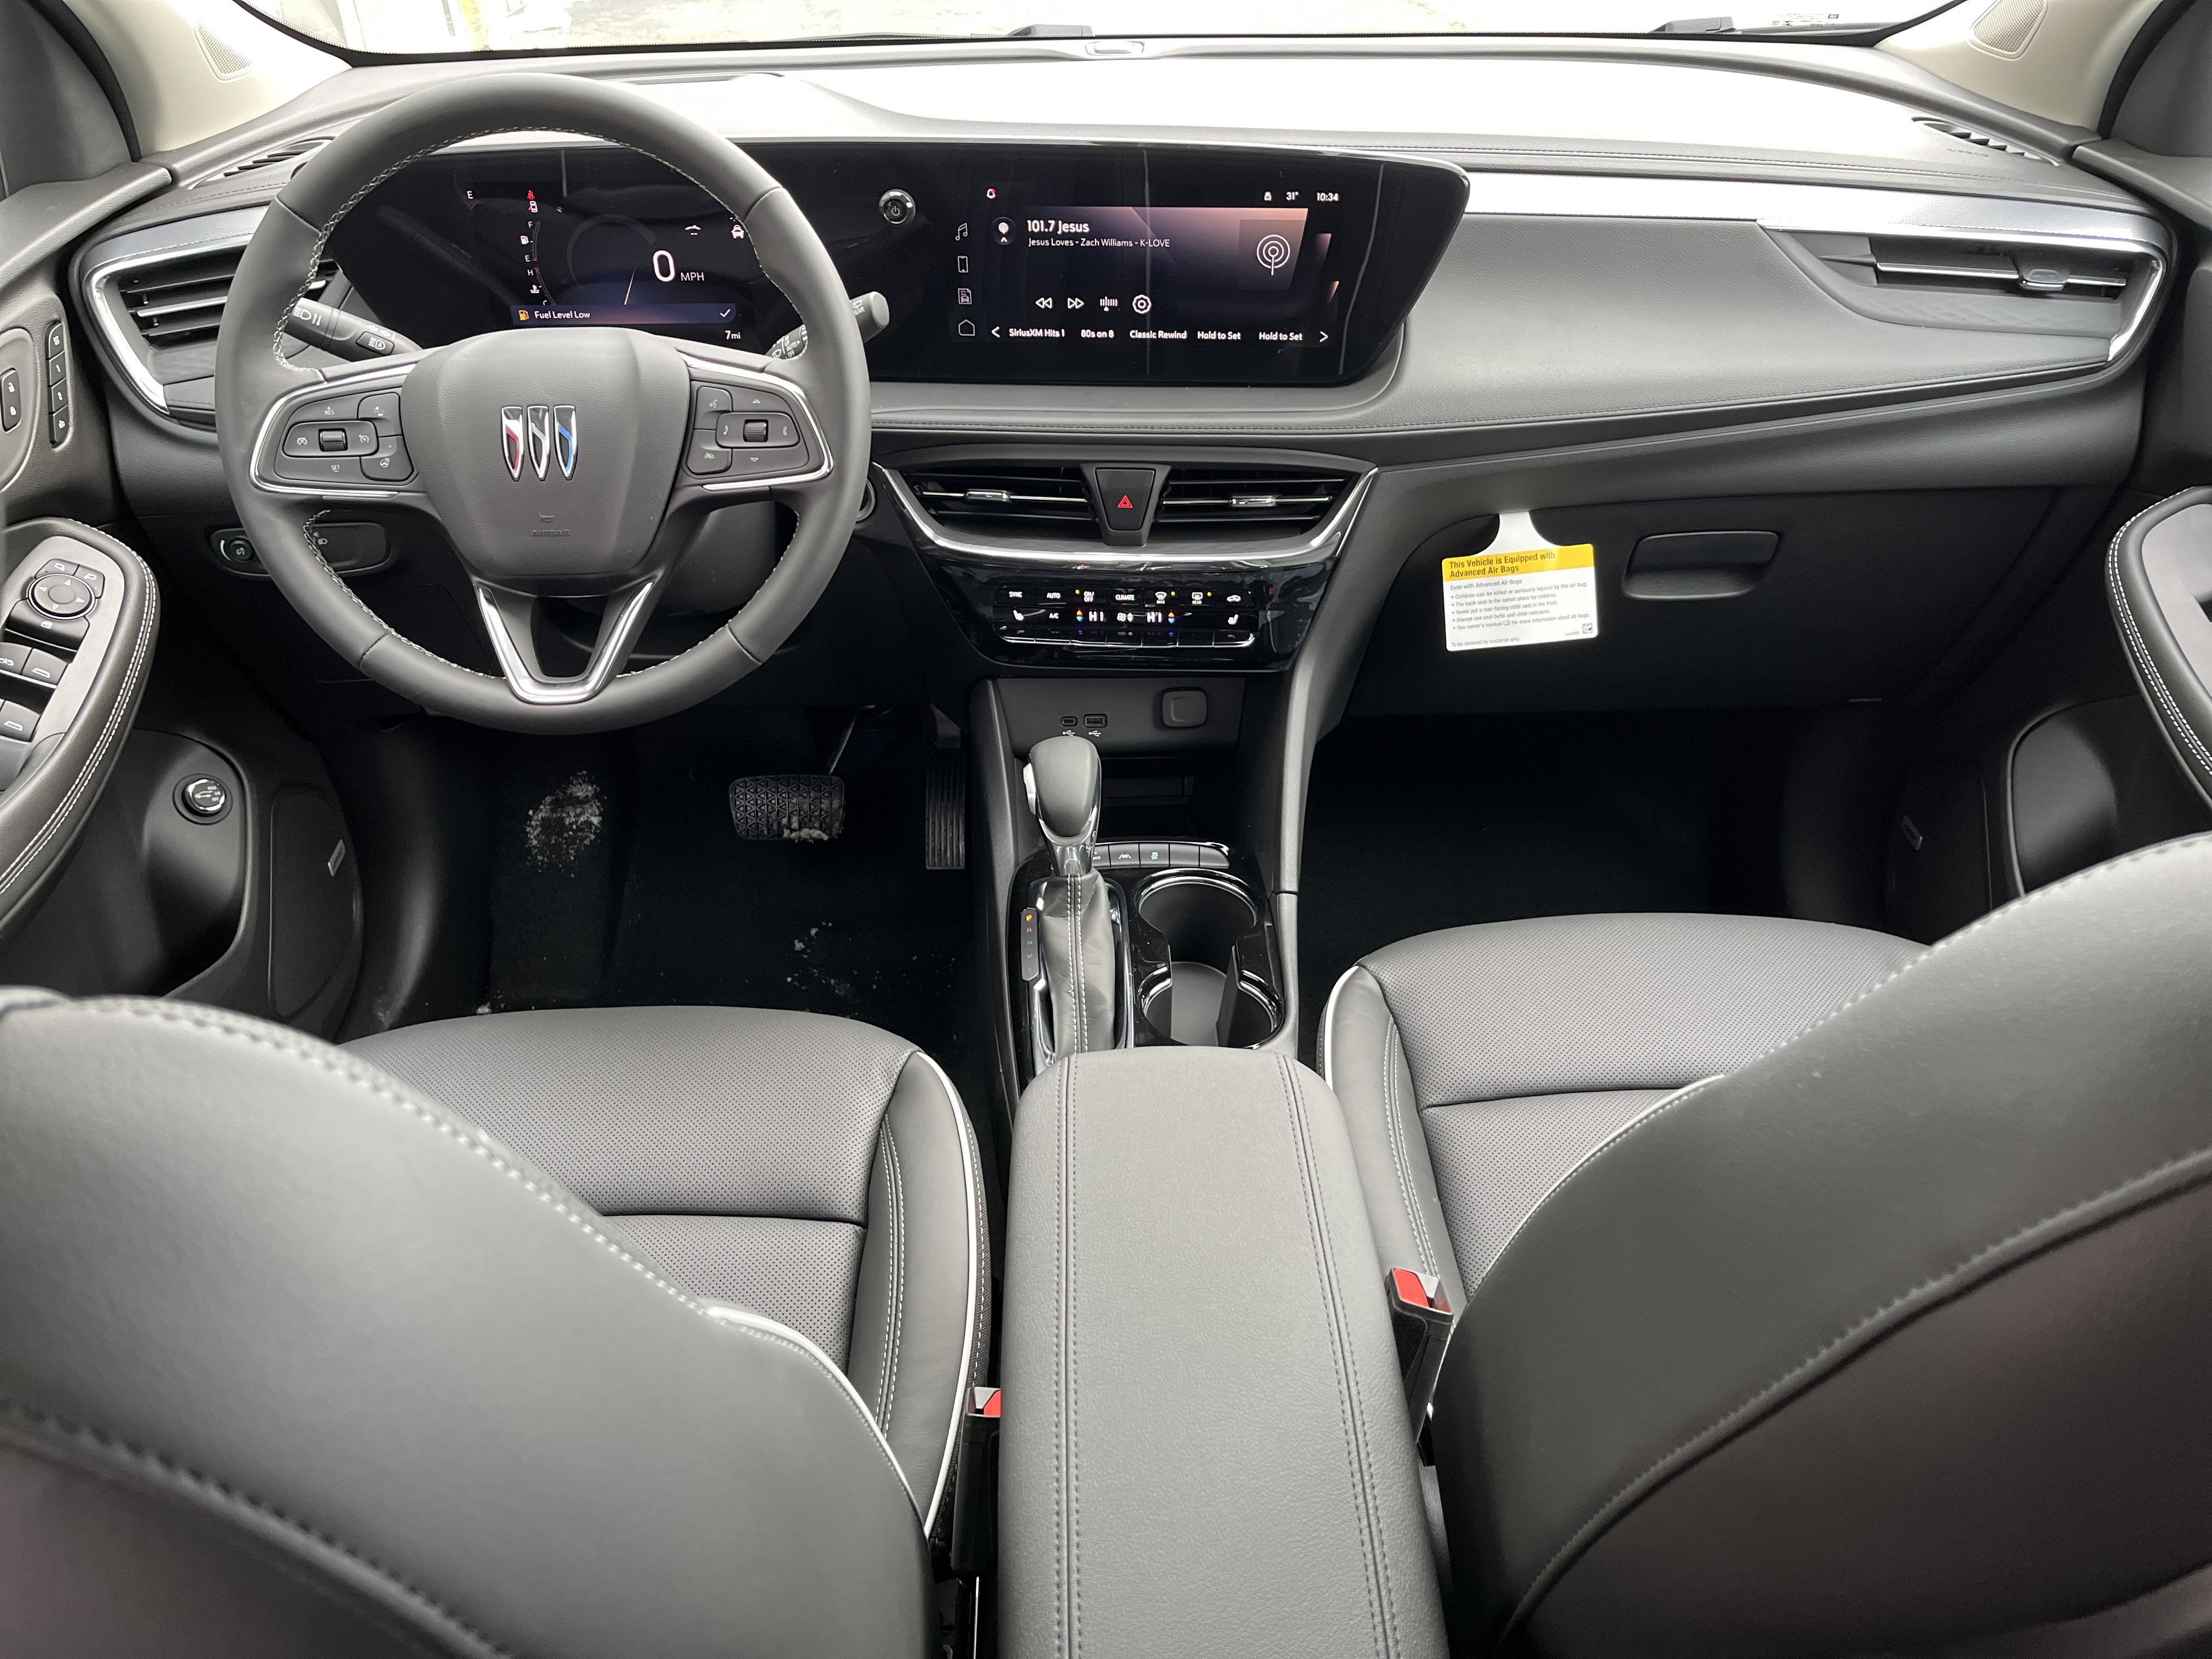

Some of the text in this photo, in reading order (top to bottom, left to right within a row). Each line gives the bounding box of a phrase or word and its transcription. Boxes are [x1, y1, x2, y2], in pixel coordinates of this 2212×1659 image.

[467, 190, 473, 199] E
[1286, 191, 1299, 200] 31°
[1317, 192, 1339, 201] 10:34
[1026, 219, 1090, 235] 101.7 Jesus
[1028, 238, 1049, 247] Jesus
[1051, 238, 1074, 247] Loves
[1080, 238, 1100, 247] Zach
[1101, 238, 1133, 247] Williams
[1140, 239, 1170, 248] K-LOVE
[653, 250, 704, 282] 0 MPH
[534, 310, 590, 319] Fuel Level Low
[1009, 328, 1065, 338] SiriusXM Hits 1
[1081, 330, 1096, 338] 80s
[1108, 330, 1114, 338] 8
[1130, 330, 1187, 339] Classic Rewind
[1198, 331, 1242, 340] Hold to Set
[1259, 331, 1303, 341] Hold to Set
[786, 341, 797, 352] AUTO
[1449, 560, 1465, 569] This
[1466, 557, 1493, 567] Vehicle
[1504, 552, 1538, 565] Equipped
[1539, 551, 1555, 560] with
[1450, 565, 1520, 578] Advanced Air Bags
[1475, 580, 1500, 588] Advanced
